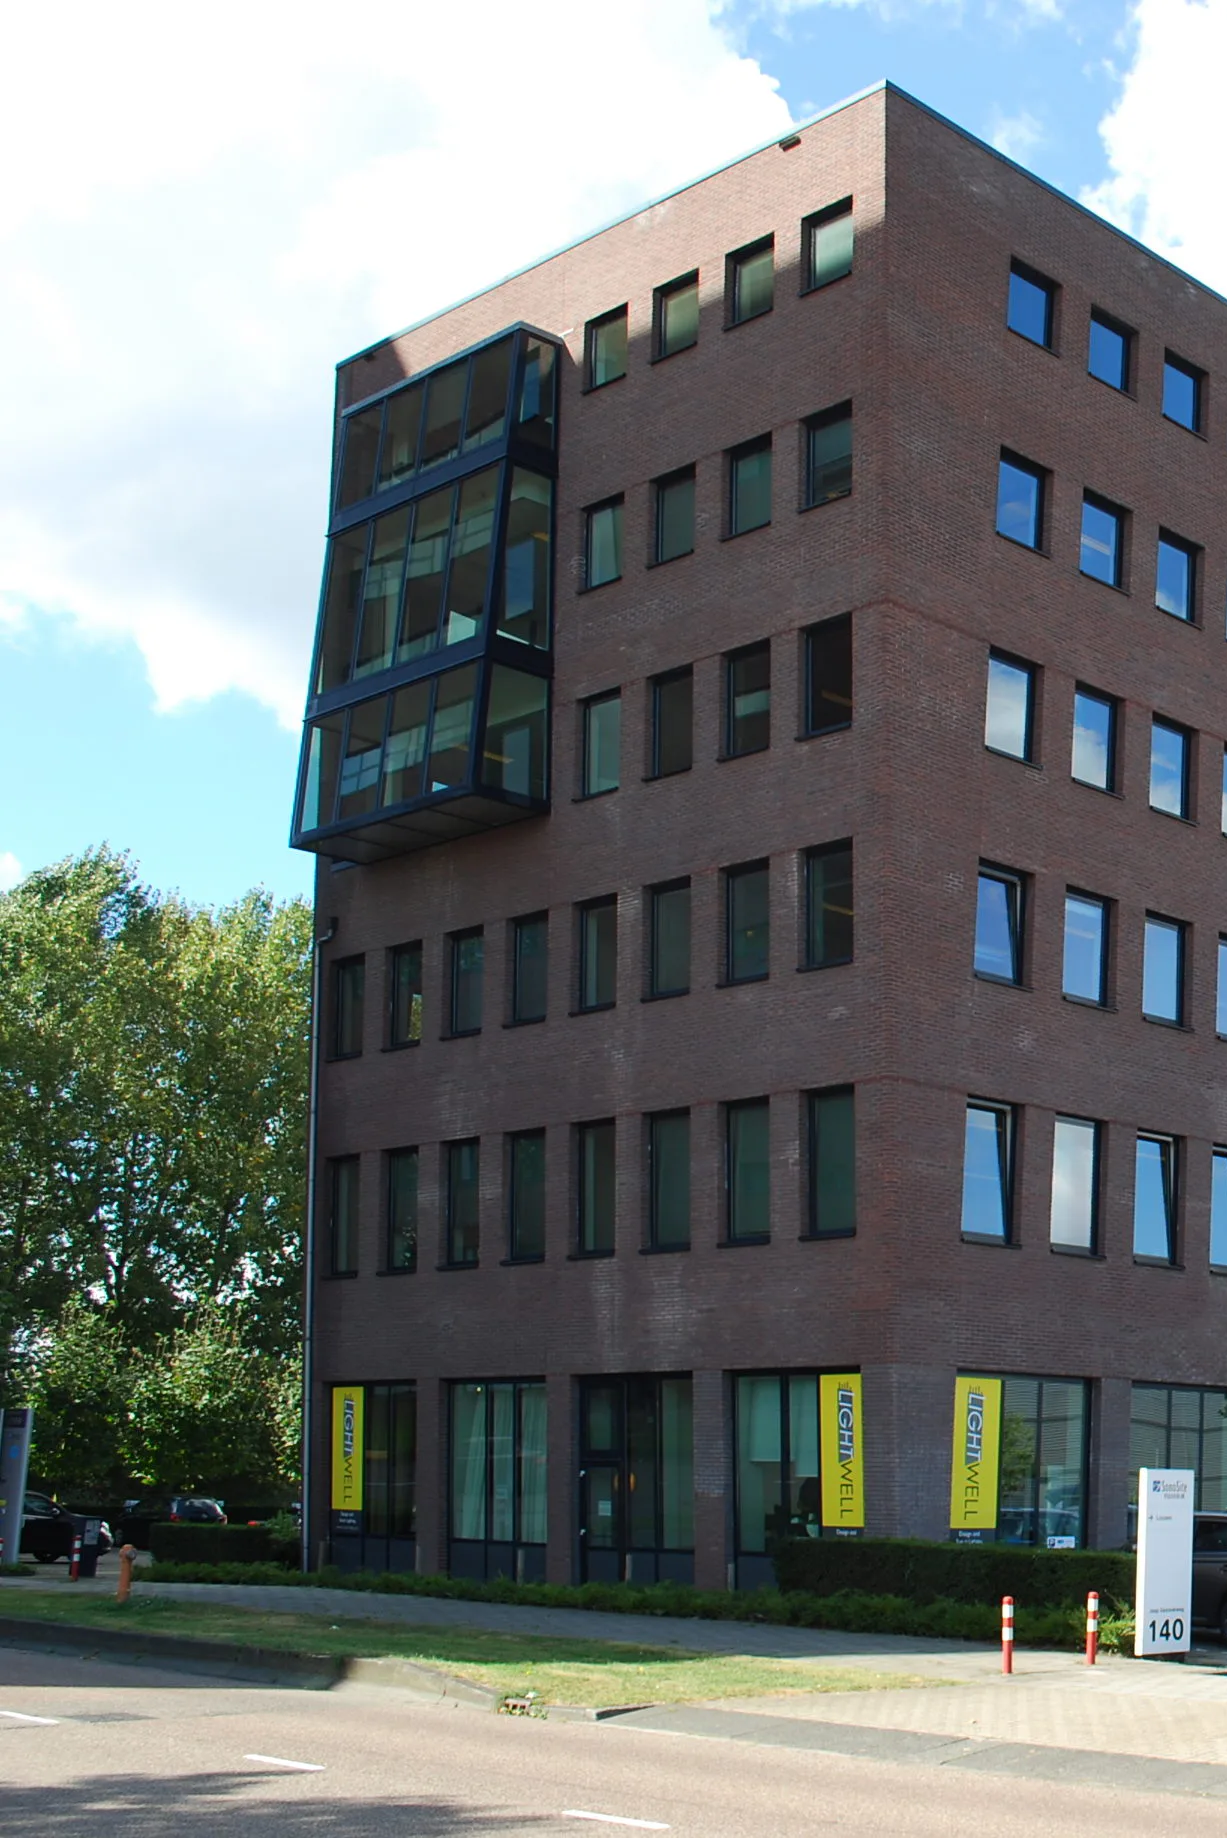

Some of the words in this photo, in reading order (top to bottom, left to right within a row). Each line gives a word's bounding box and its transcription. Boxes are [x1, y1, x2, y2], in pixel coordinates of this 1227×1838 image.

[343, 1399, 355, 1503] LIGHTWELL
[838, 1389, 856, 1519] LIGHTWELL
[963, 1392, 986, 1520] LIGHTWELL
[1149, 1618, 1184, 1642] 140
